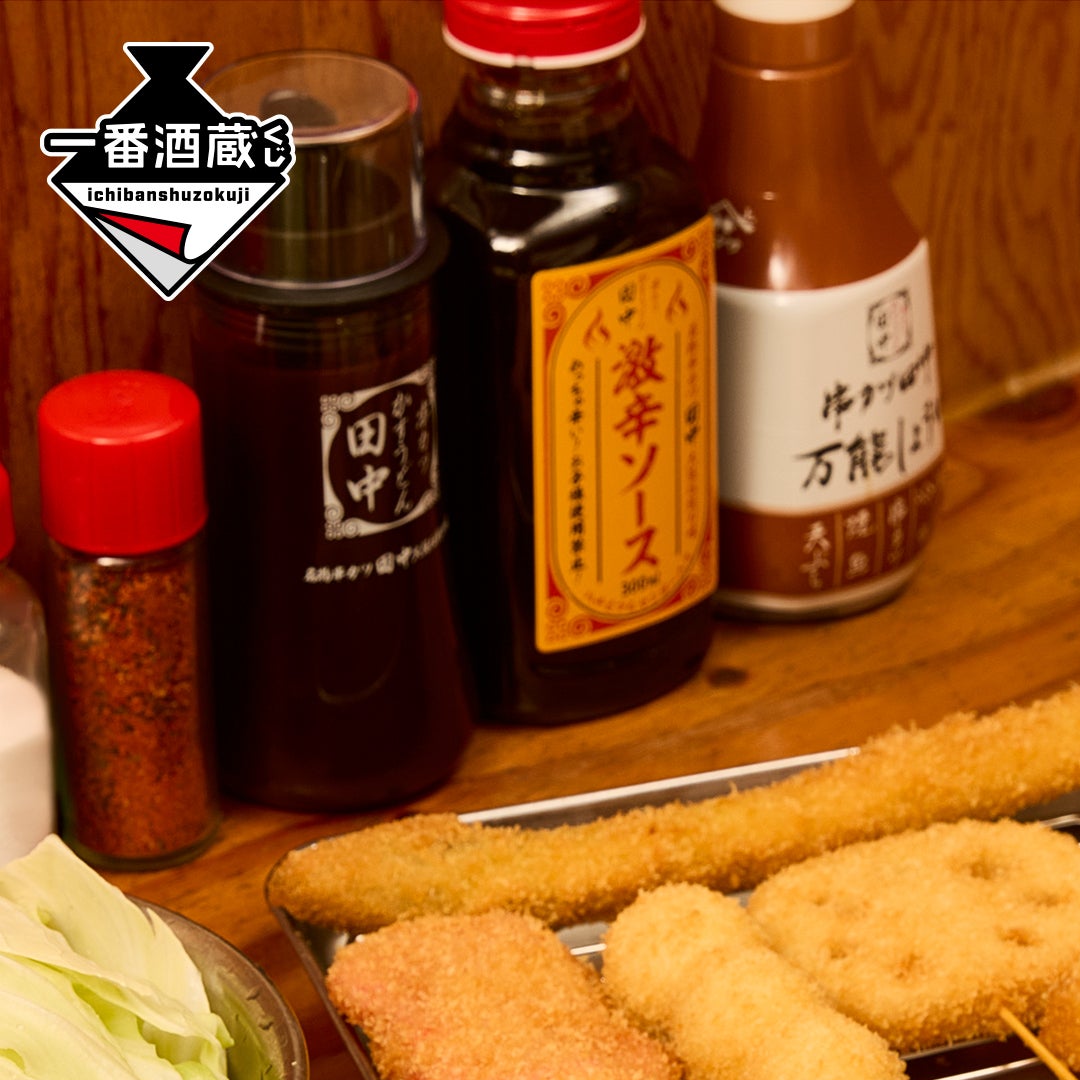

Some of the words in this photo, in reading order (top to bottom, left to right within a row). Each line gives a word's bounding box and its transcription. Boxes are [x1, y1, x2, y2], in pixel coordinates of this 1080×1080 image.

[346, 411, 391, 513] 田中
[611, 336, 666, 574] 激辛ソース
